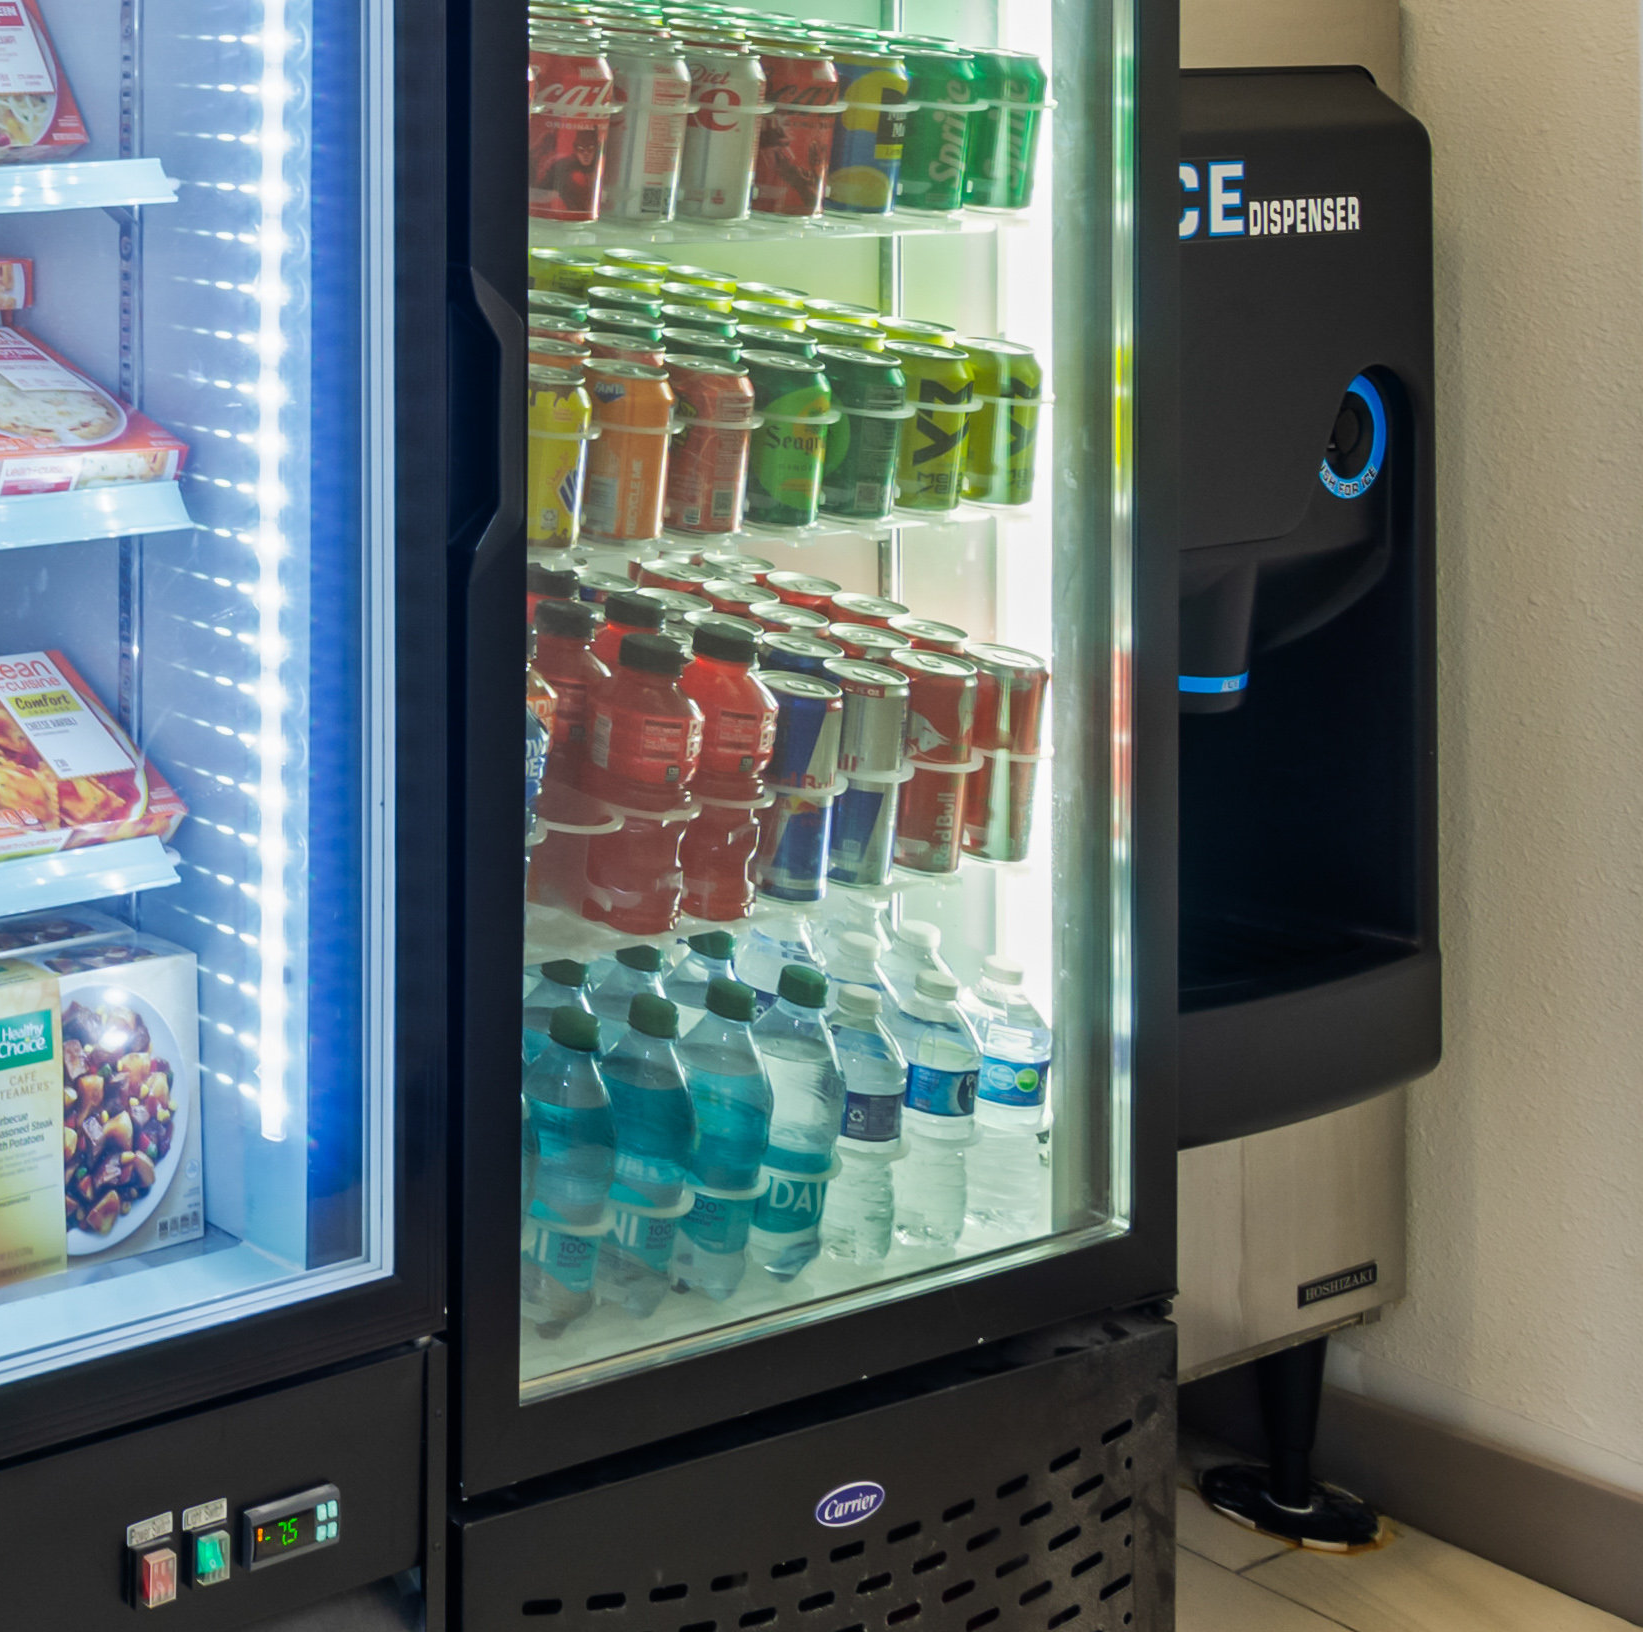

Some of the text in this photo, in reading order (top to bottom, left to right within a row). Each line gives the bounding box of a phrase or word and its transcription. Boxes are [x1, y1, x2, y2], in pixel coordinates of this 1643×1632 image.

[928, 78, 972, 186] Sprite
[1179, 161, 1361, 240] CE DISPENSER
[15, 693, 70, 712] Comfort
[936, 792, 956, 827] Bull
[2, 1023, 44, 1042] Healthy
[9, 1134, 45, 1149] Potatoes
[31, 1119, 53, 1132] Steak
[1304, 1268, 1374, 1302] HOSHIZAKI
[823, 1491, 878, 1524] Carrier
